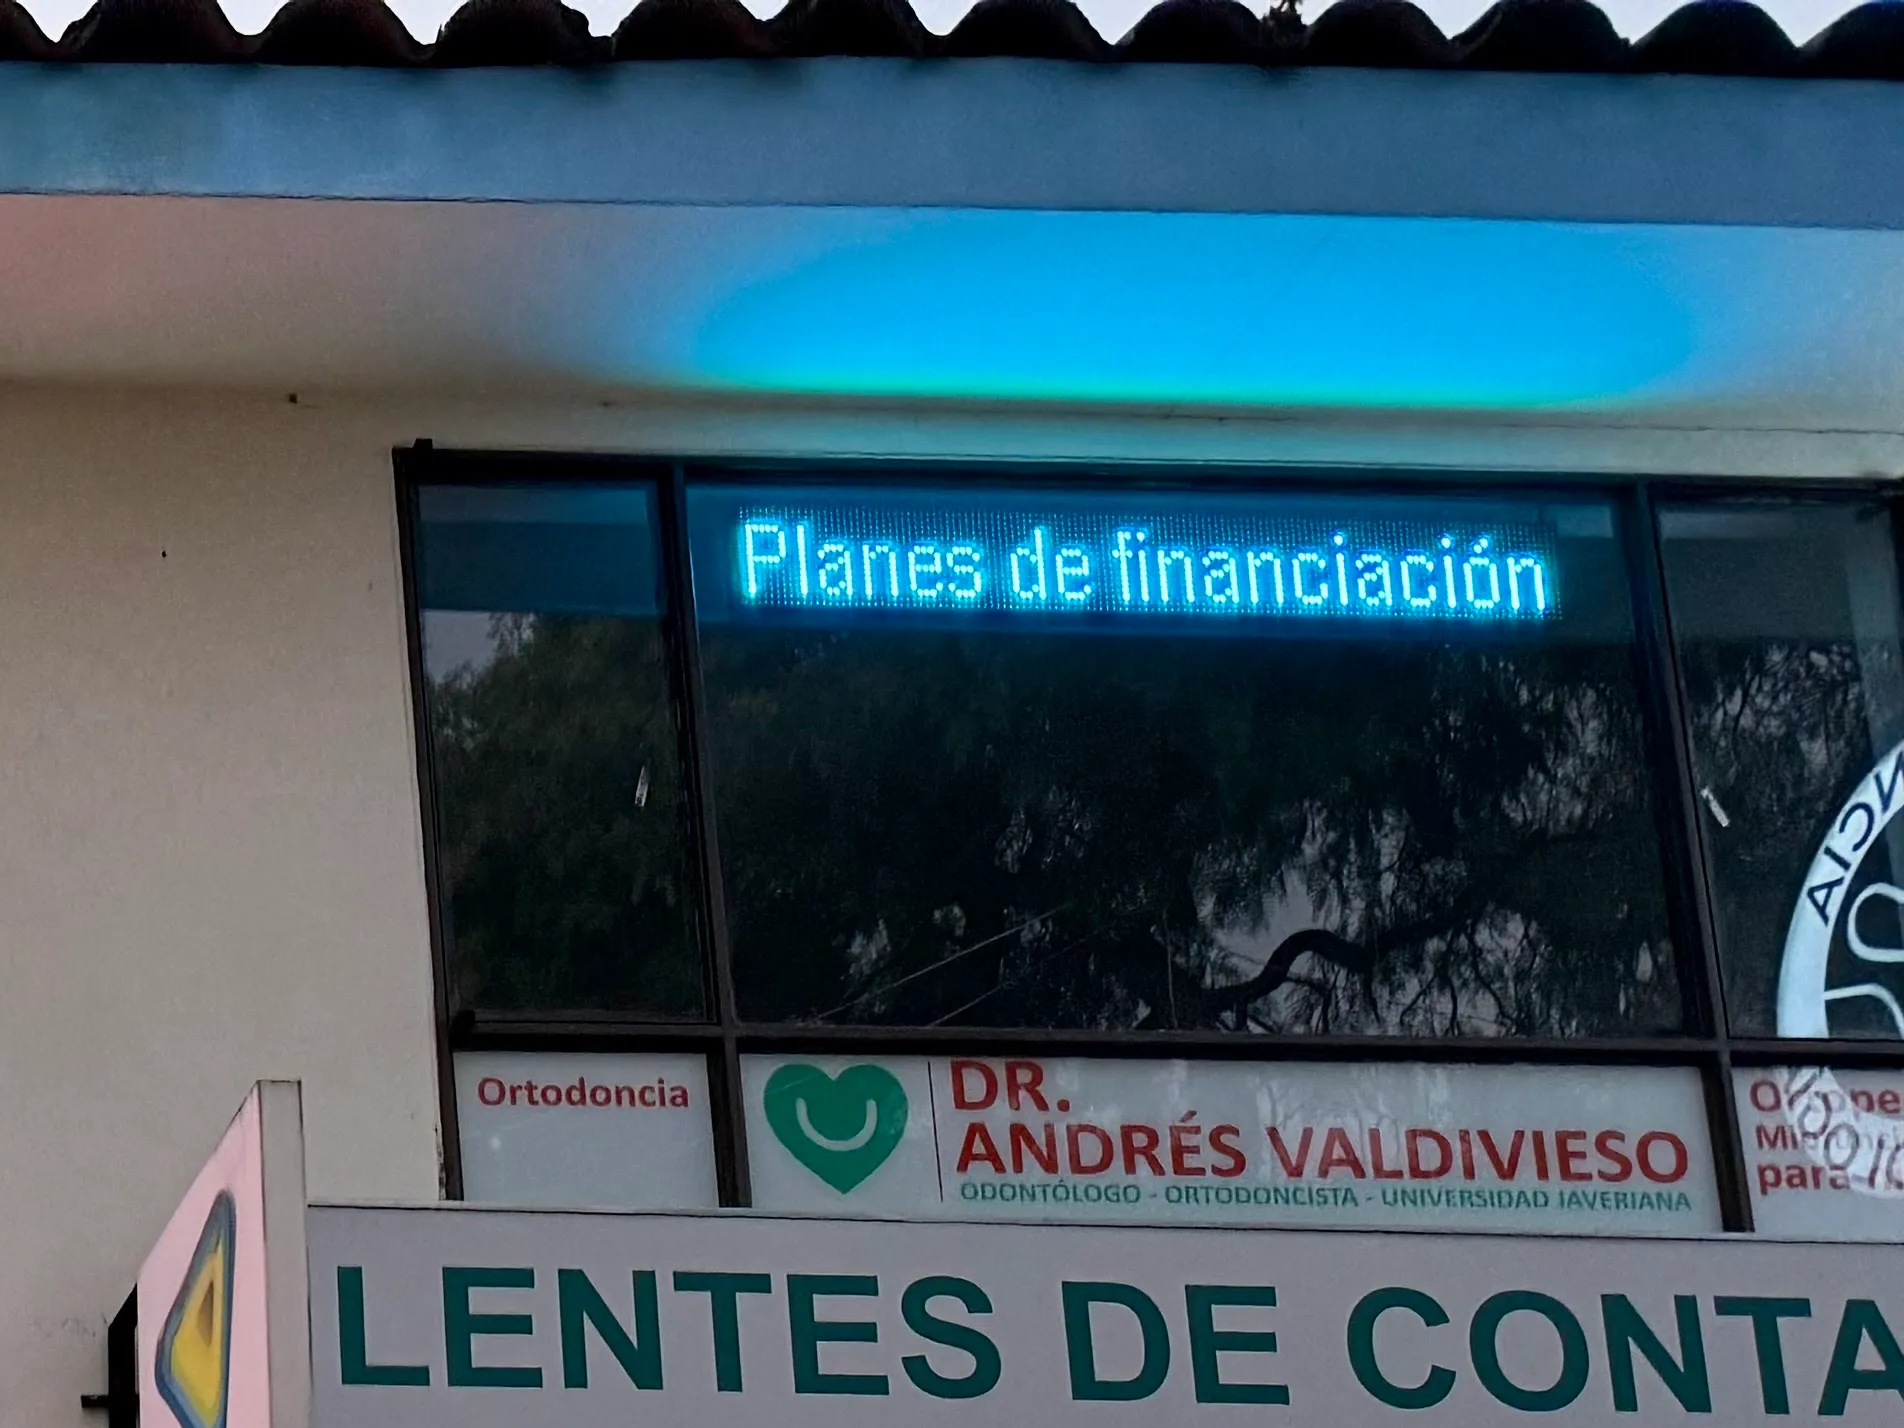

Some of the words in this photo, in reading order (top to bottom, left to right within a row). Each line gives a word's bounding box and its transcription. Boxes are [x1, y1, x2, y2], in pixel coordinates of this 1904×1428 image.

[741, 518, 984, 602] Planes
[1008, 526, 1093, 604] de
[1110, 530, 1548, 614] financiación
[476, 1075, 692, 1113] Ortodoncia
[950, 1058, 1070, 1113] DR.
[954, 1112, 1247, 1178] ANDRÉS
[1265, 1124, 1691, 1185] VALDIVIESO
[958, 1177, 1142, 1204] ODONTÓLOGO
[1164, 1185, 1359, 1209] ORTODONCISTA
[1380, 1187, 1550, 1210] UNIVERSIDAD
[1757, 1162, 1852, 1197] para
[335, 1264, 1004, 1400] LENTES
[1060, 1279, 1291, 1408] DE
